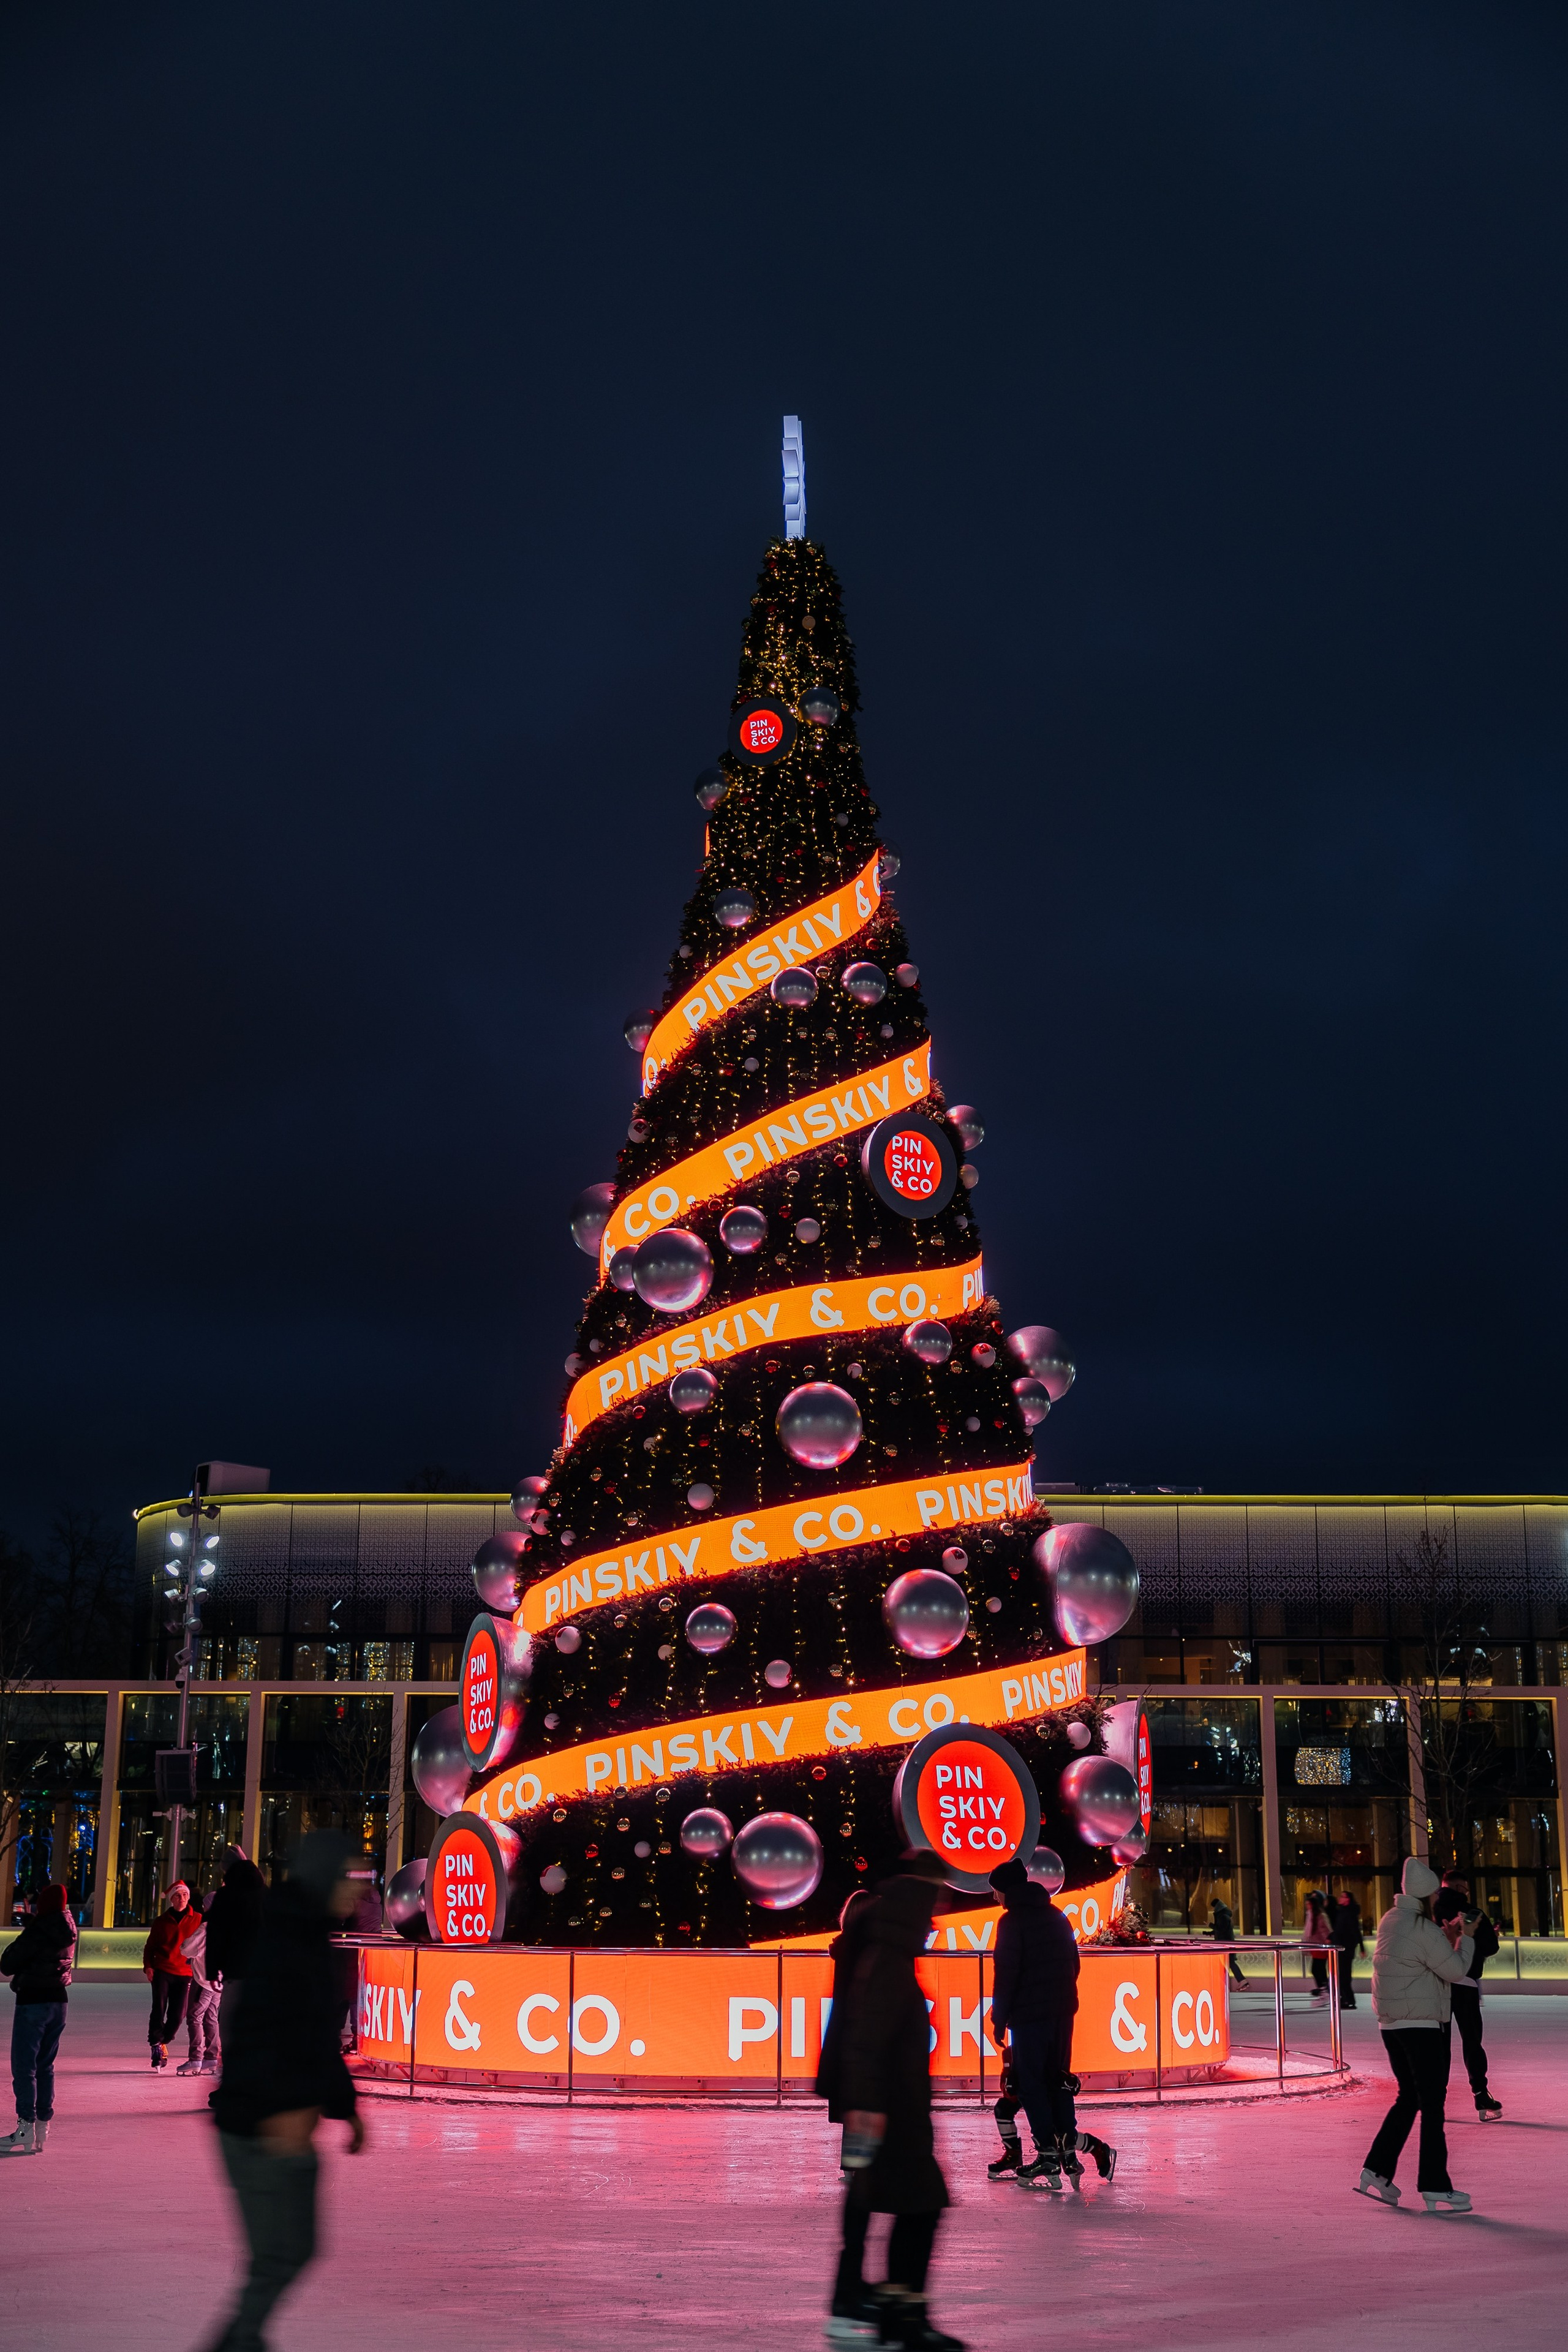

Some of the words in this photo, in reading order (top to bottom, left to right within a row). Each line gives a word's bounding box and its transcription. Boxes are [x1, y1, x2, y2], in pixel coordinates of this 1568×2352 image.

[750, 719, 767, 729] PIN
[750, 726, 775, 738] SKIY
[752, 737, 759, 746] &
[761, 736, 778, 745] CO.
[682, 903, 842, 1033] PINSKIY
[855, 880, 872, 918] &
[624, 1186, 696, 1237] CO.
[723, 1076, 891, 1180] PINSKIY
[903, 1058, 923, 1096] &
[892, 1136, 921, 1155] PIN
[892, 1154, 934, 1175] SKIY
[891, 1170, 903, 1188] &
[907, 1176, 935, 1193] CO
[599, 1303, 780, 1408] PINSKIY
[810, 1288, 845, 1328] &
[867, 1284, 938, 1321] CO.
[545, 1537, 701, 1624] PINSKIY
[730, 1519, 768, 1563] &
[793, 1504, 881, 1548] CO.
[470, 1653, 486, 1679] PIN
[470, 1678, 492, 1706] SKIY
[470, 1709, 477, 1734] &
[478, 1707, 494, 1731] CO.
[497, 1773, 555, 1819] CO.
[586, 1716, 794, 1793] PINSKIY
[824, 1701, 863, 1747] &
[888, 1694, 970, 1737] CO.
[1001, 1660, 1082, 1719] PINSKIY
[936, 1765, 983, 1789] PIN
[1140, 1764, 1149, 1788] SKIY
[939, 1795, 1005, 1820] SKIY
[942, 1821, 962, 1849] &
[968, 1826, 1016, 1850] CO.
[445, 1854, 473, 1878] PIN
[446, 1883, 486, 1907] SKIY
[447, 1909, 459, 1937] &
[462, 1913, 491, 1937] CO.
[364, 1983, 421, 2045] SKIY
[444, 1980, 481, 2051] &
[517, 1993, 646, 2057] CO.
[1110, 1981, 1148, 2053] &
[1171, 1989, 1220, 2049] CO.
